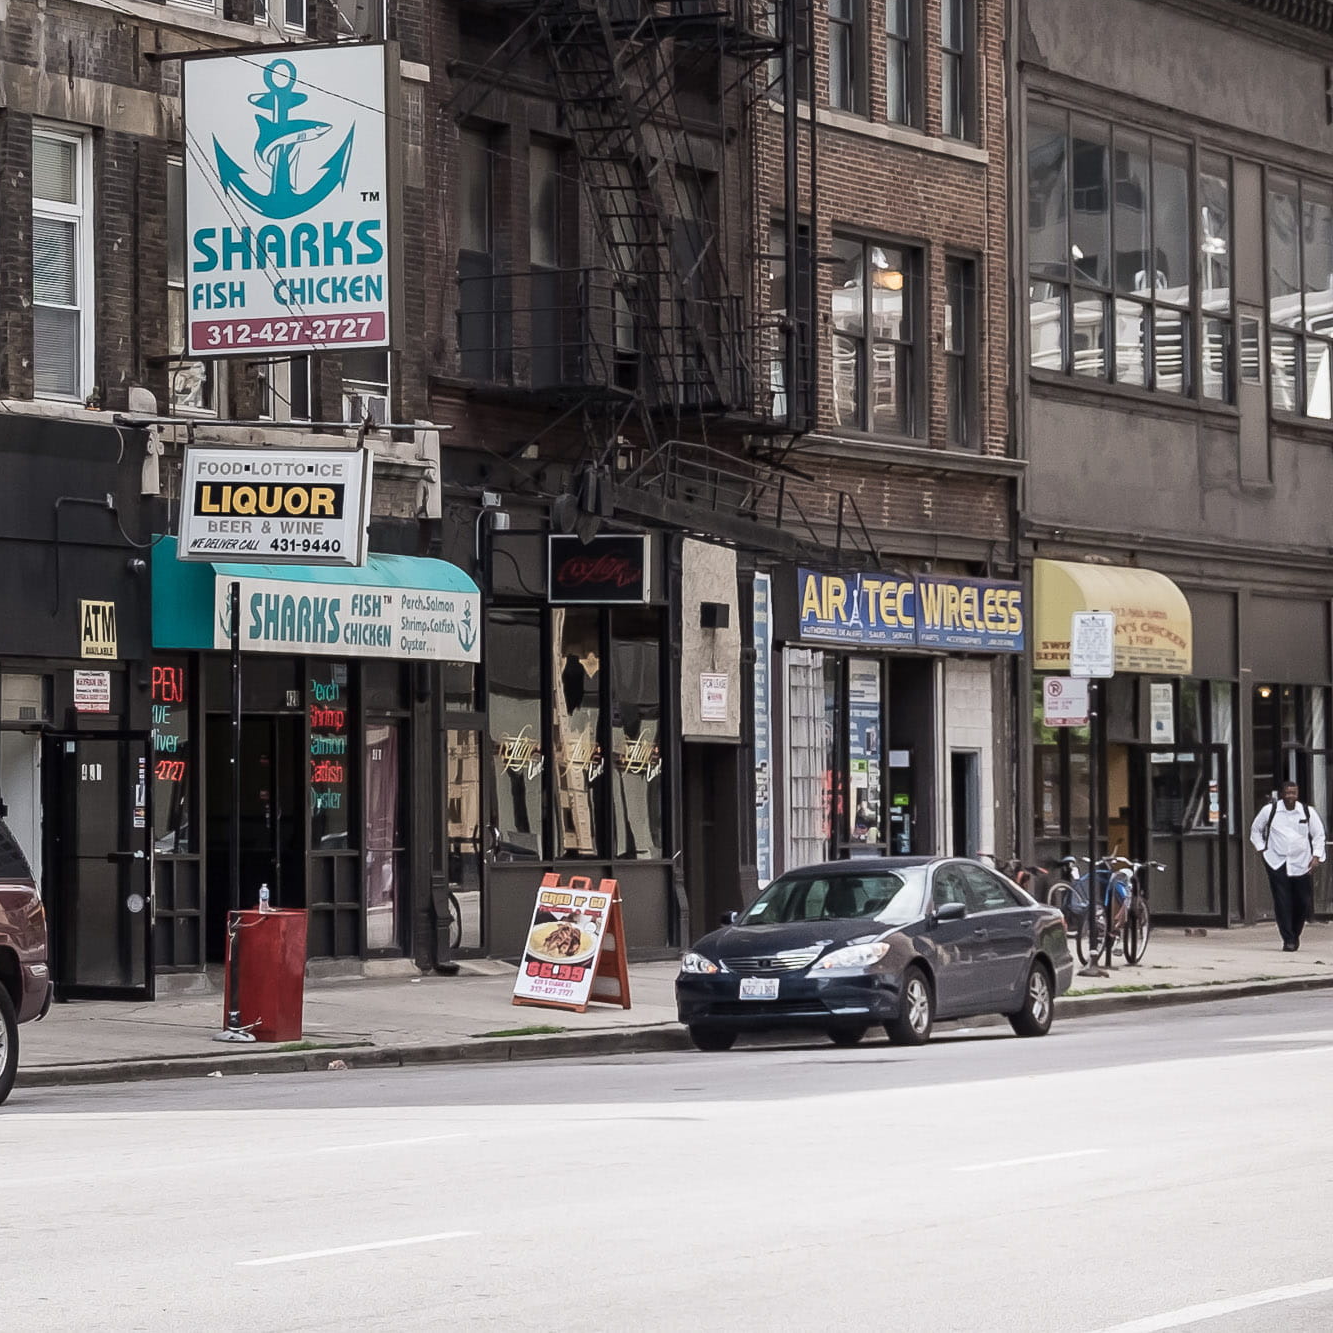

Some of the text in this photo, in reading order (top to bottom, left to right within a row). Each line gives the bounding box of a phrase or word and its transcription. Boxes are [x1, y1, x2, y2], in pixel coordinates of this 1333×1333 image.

[360, 190, 381, 202] TM
[192, 219, 384, 273] SHARKS
[192, 274, 383, 310] FISH CHICKEN
[207, 317, 373, 347] 312-427-2727
[197, 461, 344, 477] FOOD LOTTO ICE
[200, 484, 336, 516] LIQUOR
[207, 520, 325, 535] BEER & WINE
[189, 537, 342, 554] WE DELIVER CALL 431-9440
[249, 592, 341, 645] SHARKS
[350, 593, 383, 617] FISH
[801, 574, 1023, 636] AIR TEC WIRELESS
[83, 604, 116, 643] ATM
[342, 621, 392, 648] CHICKEN
